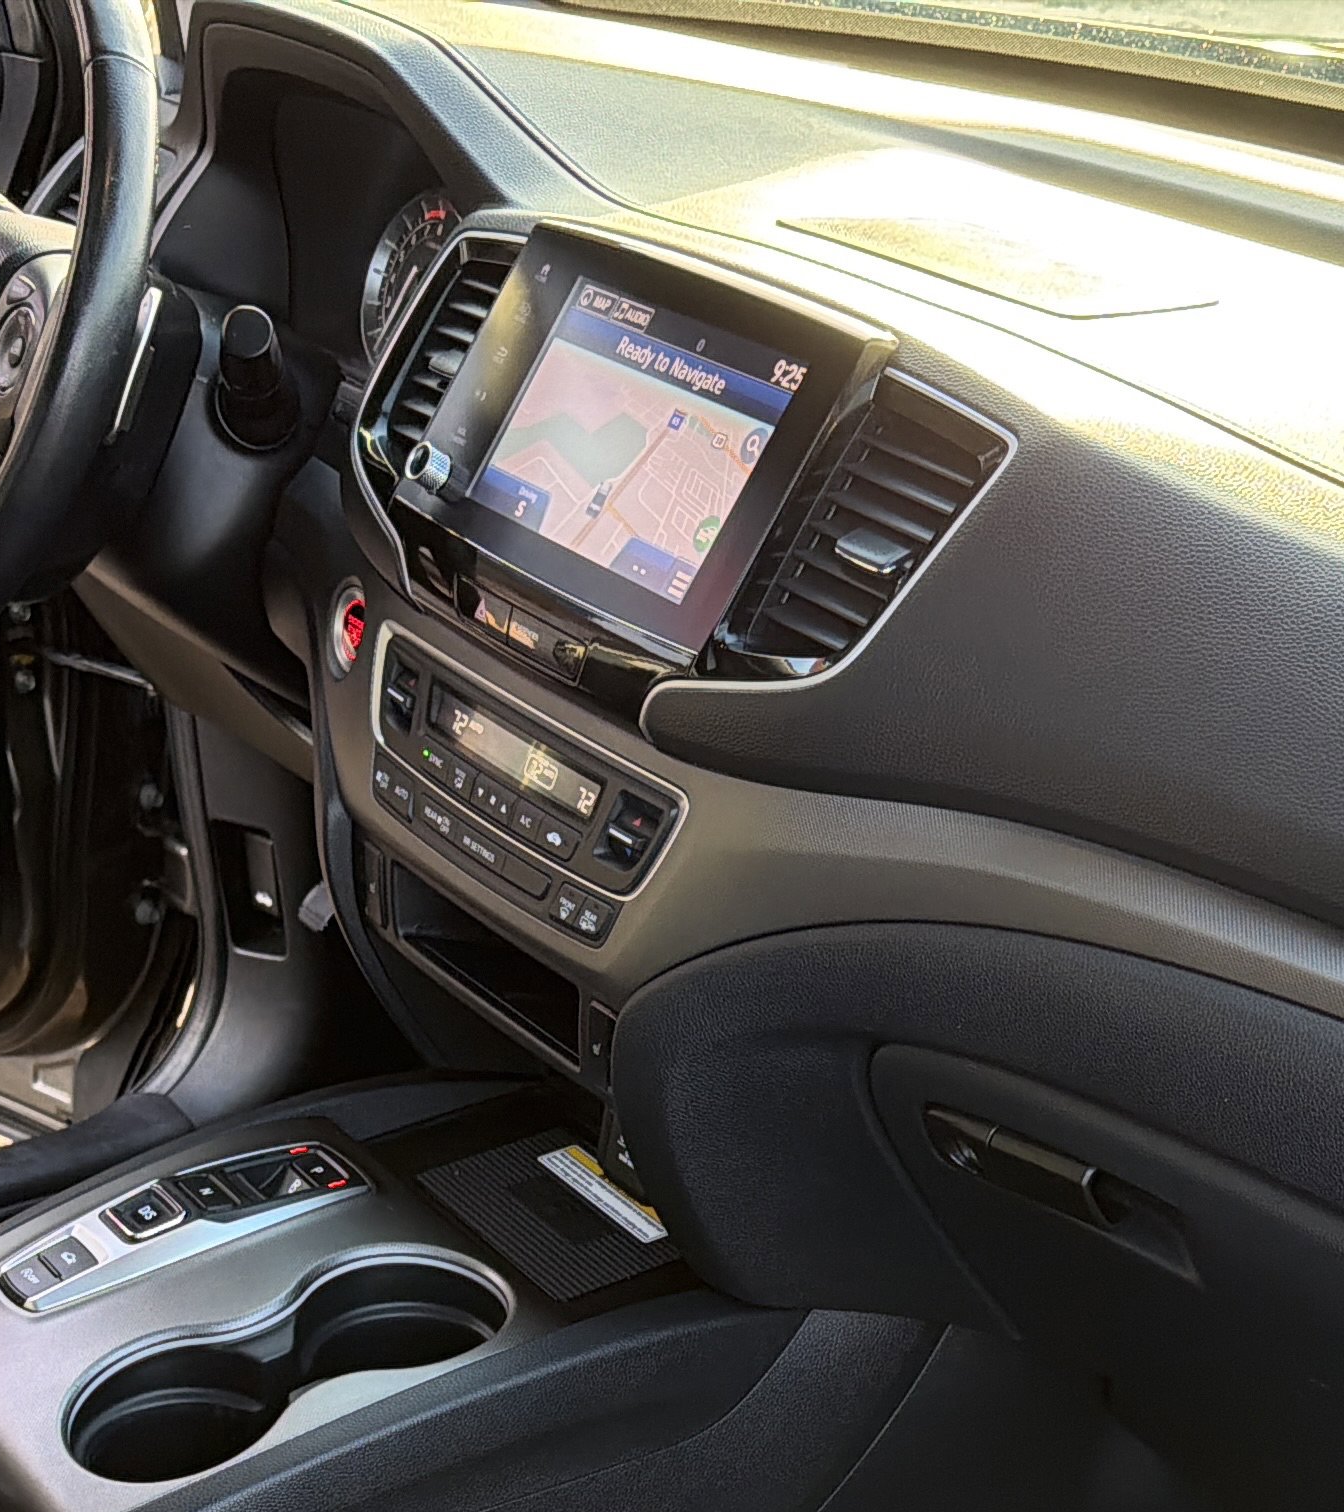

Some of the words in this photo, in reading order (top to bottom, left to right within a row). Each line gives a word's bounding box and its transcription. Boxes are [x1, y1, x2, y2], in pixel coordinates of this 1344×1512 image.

[624, 308, 651, 327] AUDIO
[615, 335, 656, 370] Ready
[654, 351, 670, 373] to
[669, 357, 726, 396] Navigate
[770, 359, 807, 391] 9:25
[514, 500, 527, 517] S
[451, 709, 469, 736] 72
[576, 786, 596, 817] 72
[519, 814, 533, 829] A/C
[310, 1166, 324, 1174] P
